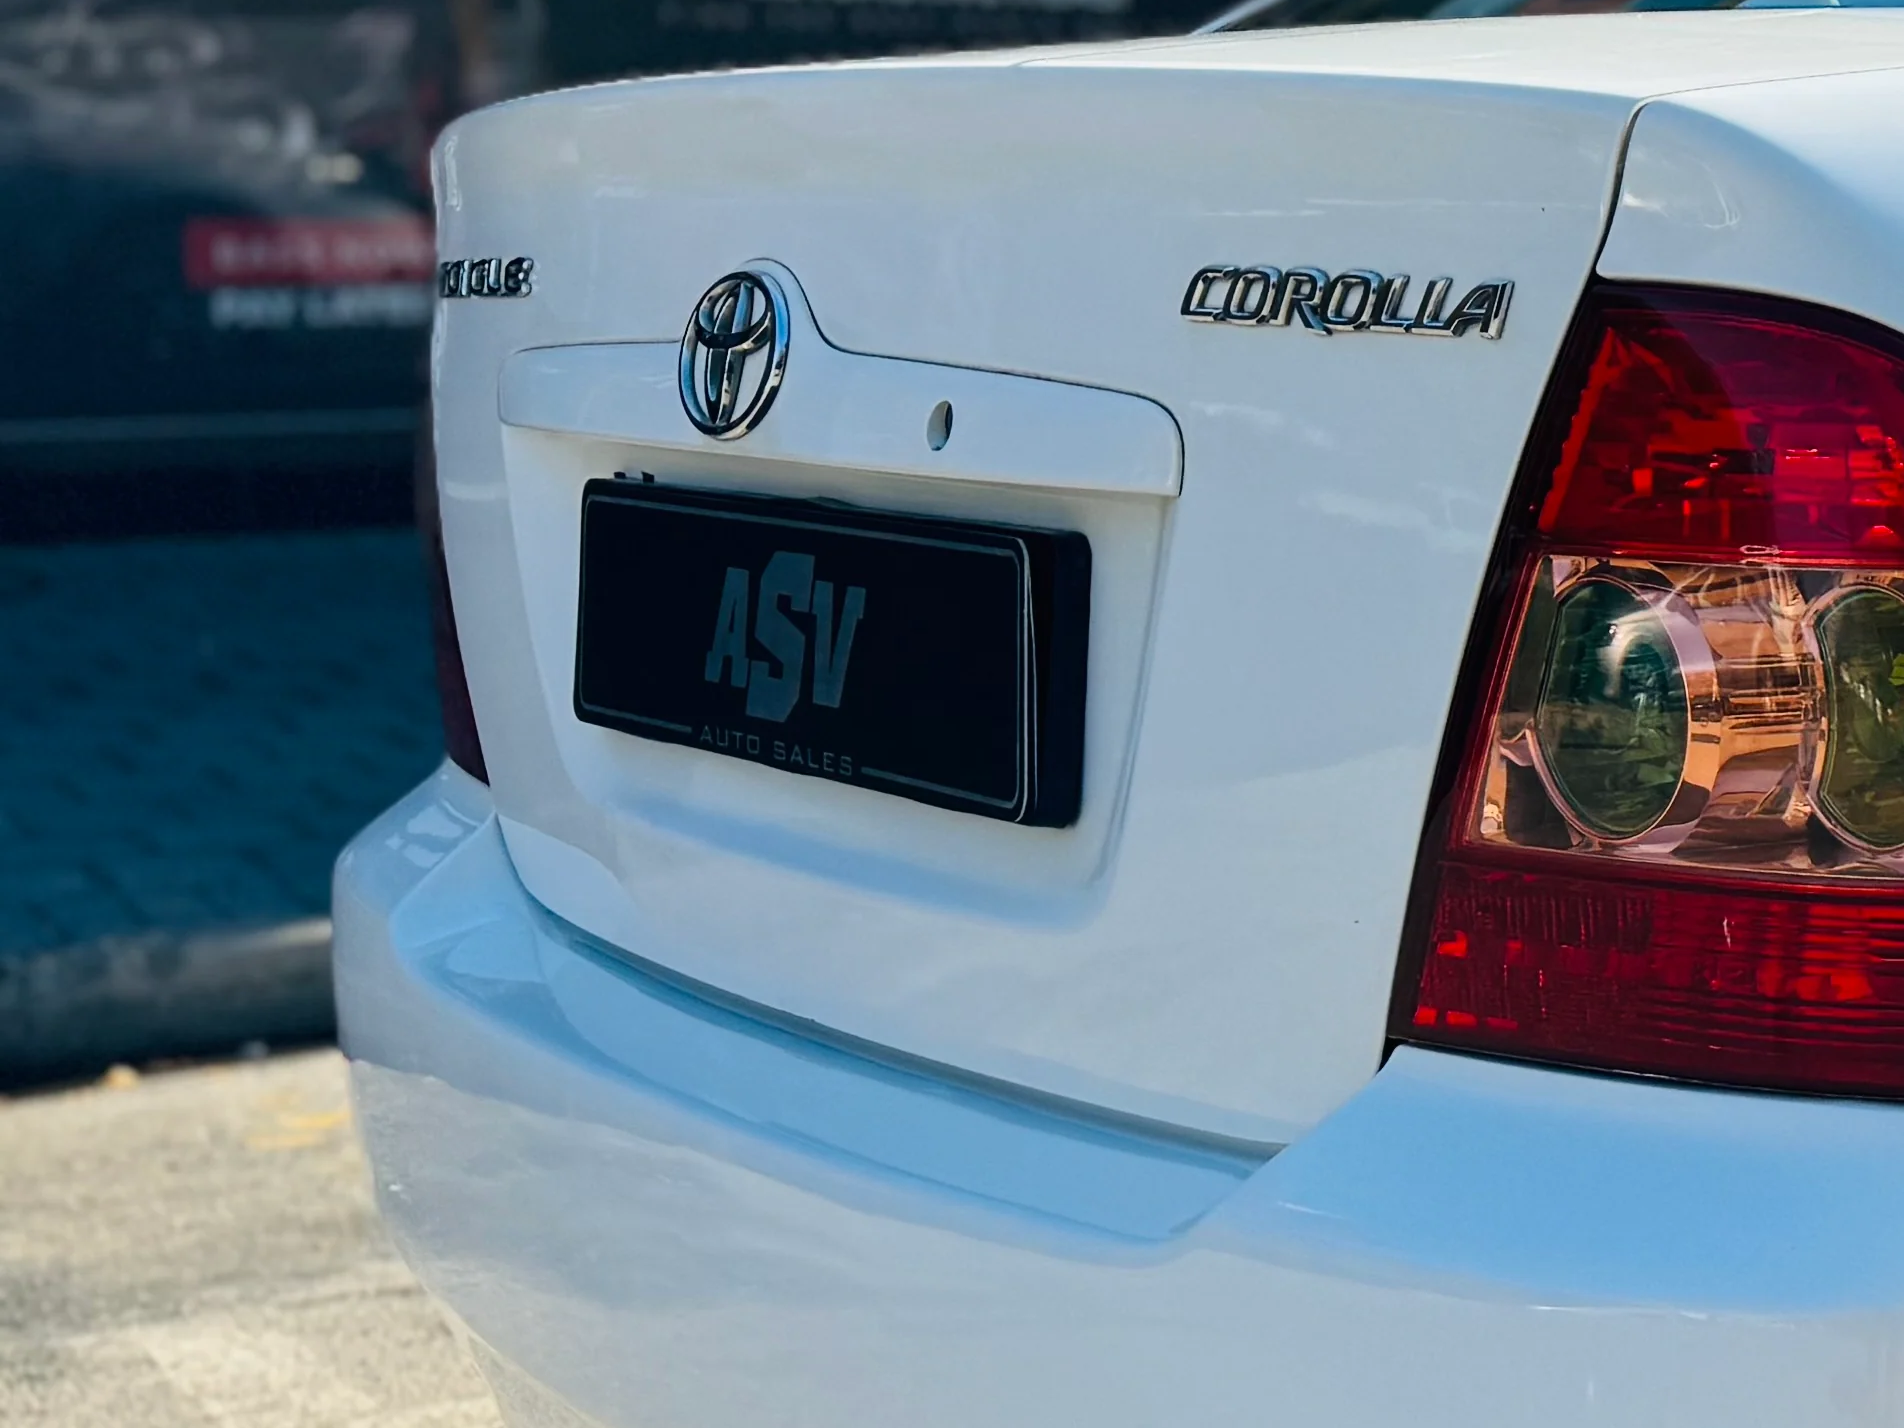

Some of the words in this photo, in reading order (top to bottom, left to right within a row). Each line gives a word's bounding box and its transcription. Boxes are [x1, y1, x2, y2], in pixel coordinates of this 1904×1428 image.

[1180, 262, 1515, 341] COROLLA
[703, 549, 867, 723] ASV
[699, 724, 762, 757] AUTO
[772, 739, 854, 777] SALES
